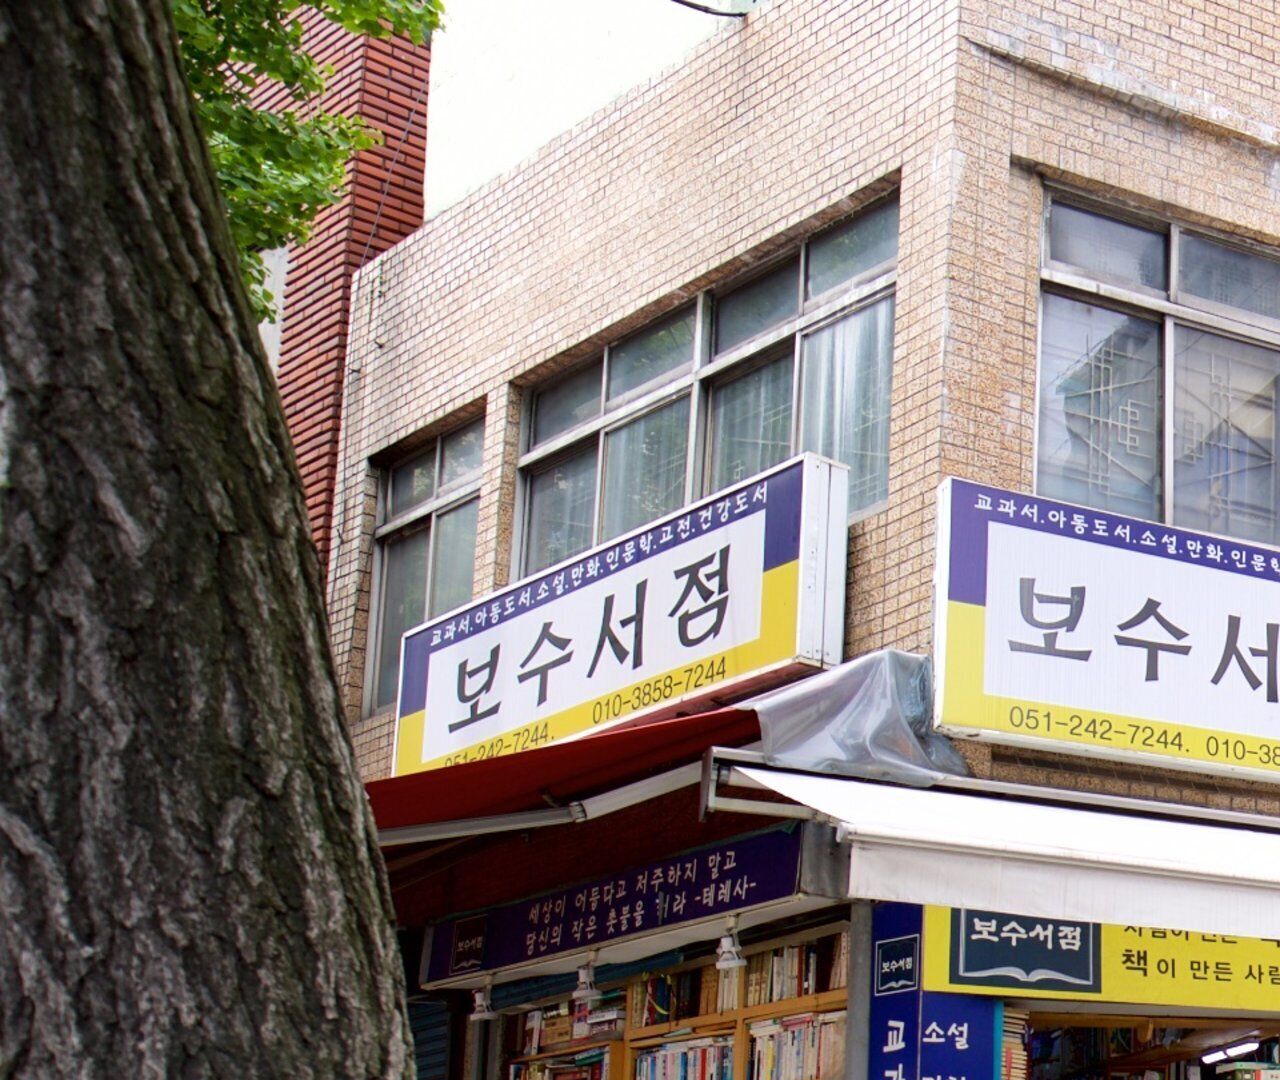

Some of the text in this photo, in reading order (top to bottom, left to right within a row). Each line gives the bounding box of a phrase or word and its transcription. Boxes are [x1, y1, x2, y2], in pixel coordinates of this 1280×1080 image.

[448, 543, 732, 735] 보수서점
[591, 655, 728, 725] 010-3858-7244
[528, 896, 566, 924] 세상이
[635, 859, 698, 894] 저주하지
[708, 850, 737, 880] 말고
[456, 935, 486, 954] 보수서점
[525, 924, 563, 957] 당신의
[571, 915, 598, 943] 작은
[971, 917, 1082, 951] 보수서점
[881, 956, 914, 973] 보수서점
[1189, 960, 1234, 982] 만든
[921, 1021, 970, 1051] 소설
